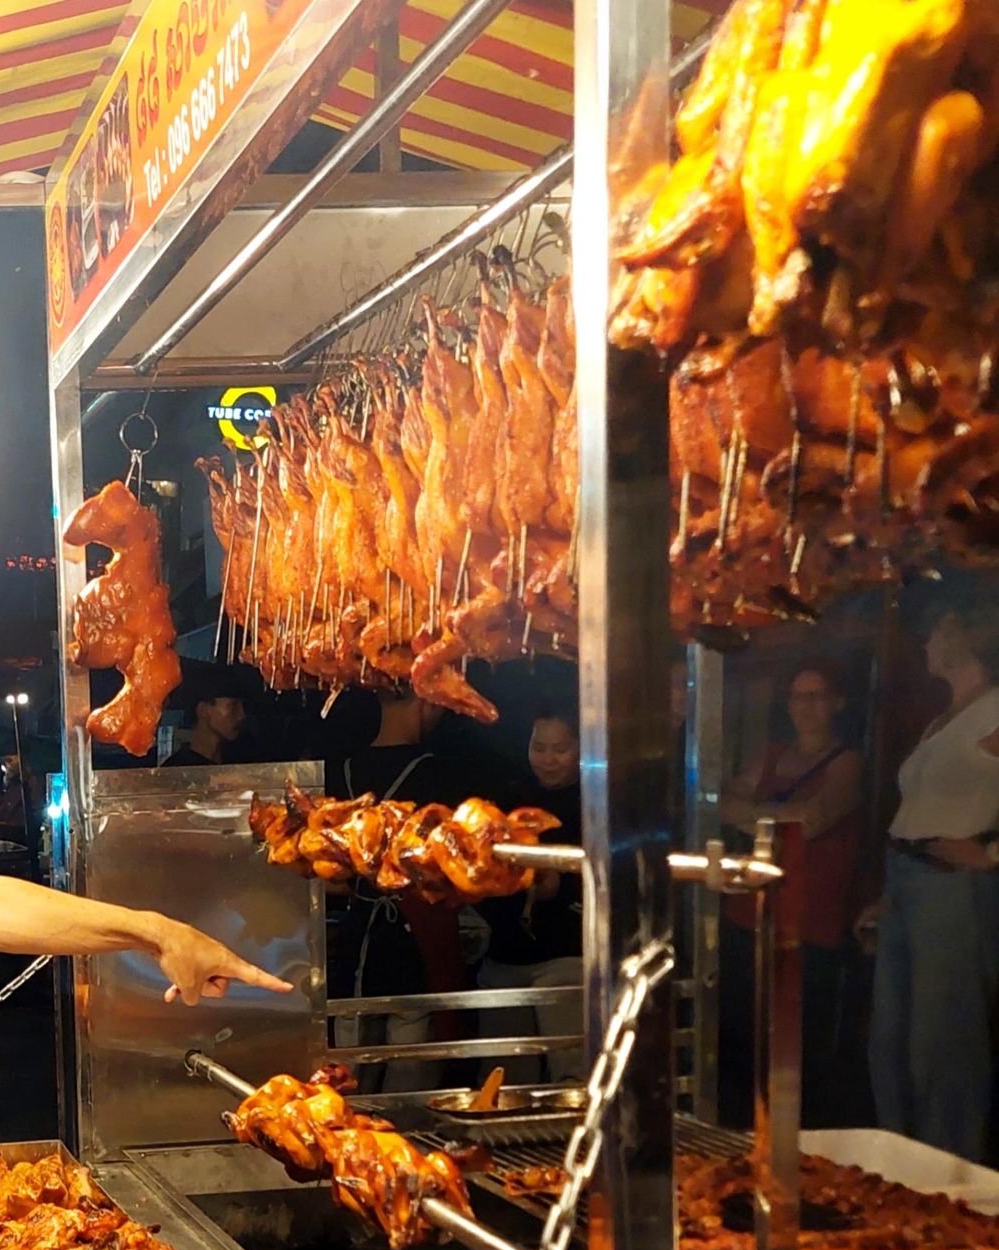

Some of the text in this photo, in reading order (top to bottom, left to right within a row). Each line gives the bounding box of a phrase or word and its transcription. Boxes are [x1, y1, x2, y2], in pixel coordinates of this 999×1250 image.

[168, 104, 191, 174] 096
[190, 66, 216, 141] 666
[216, 11, 250, 105] 7473
[208, 407, 241, 419] TUBE
